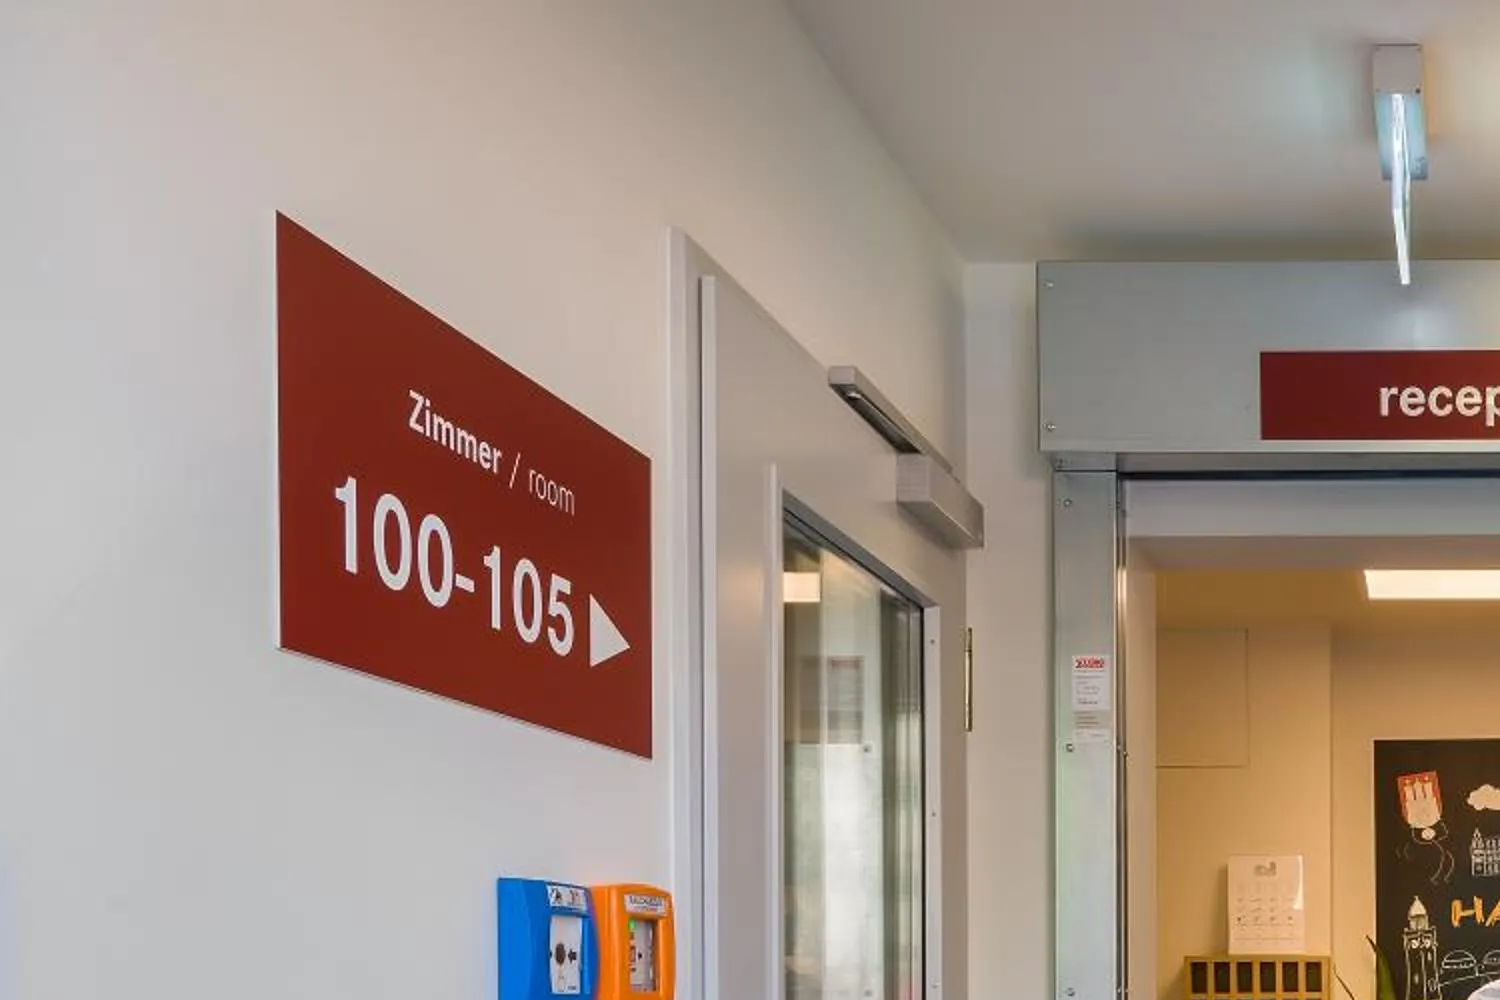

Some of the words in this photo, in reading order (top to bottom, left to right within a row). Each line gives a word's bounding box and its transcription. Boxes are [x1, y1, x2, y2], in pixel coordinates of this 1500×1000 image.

[409, 389, 502, 475] Zimmer
[529, 468, 576, 517] room
[335, 476, 575, 657] 100-105
